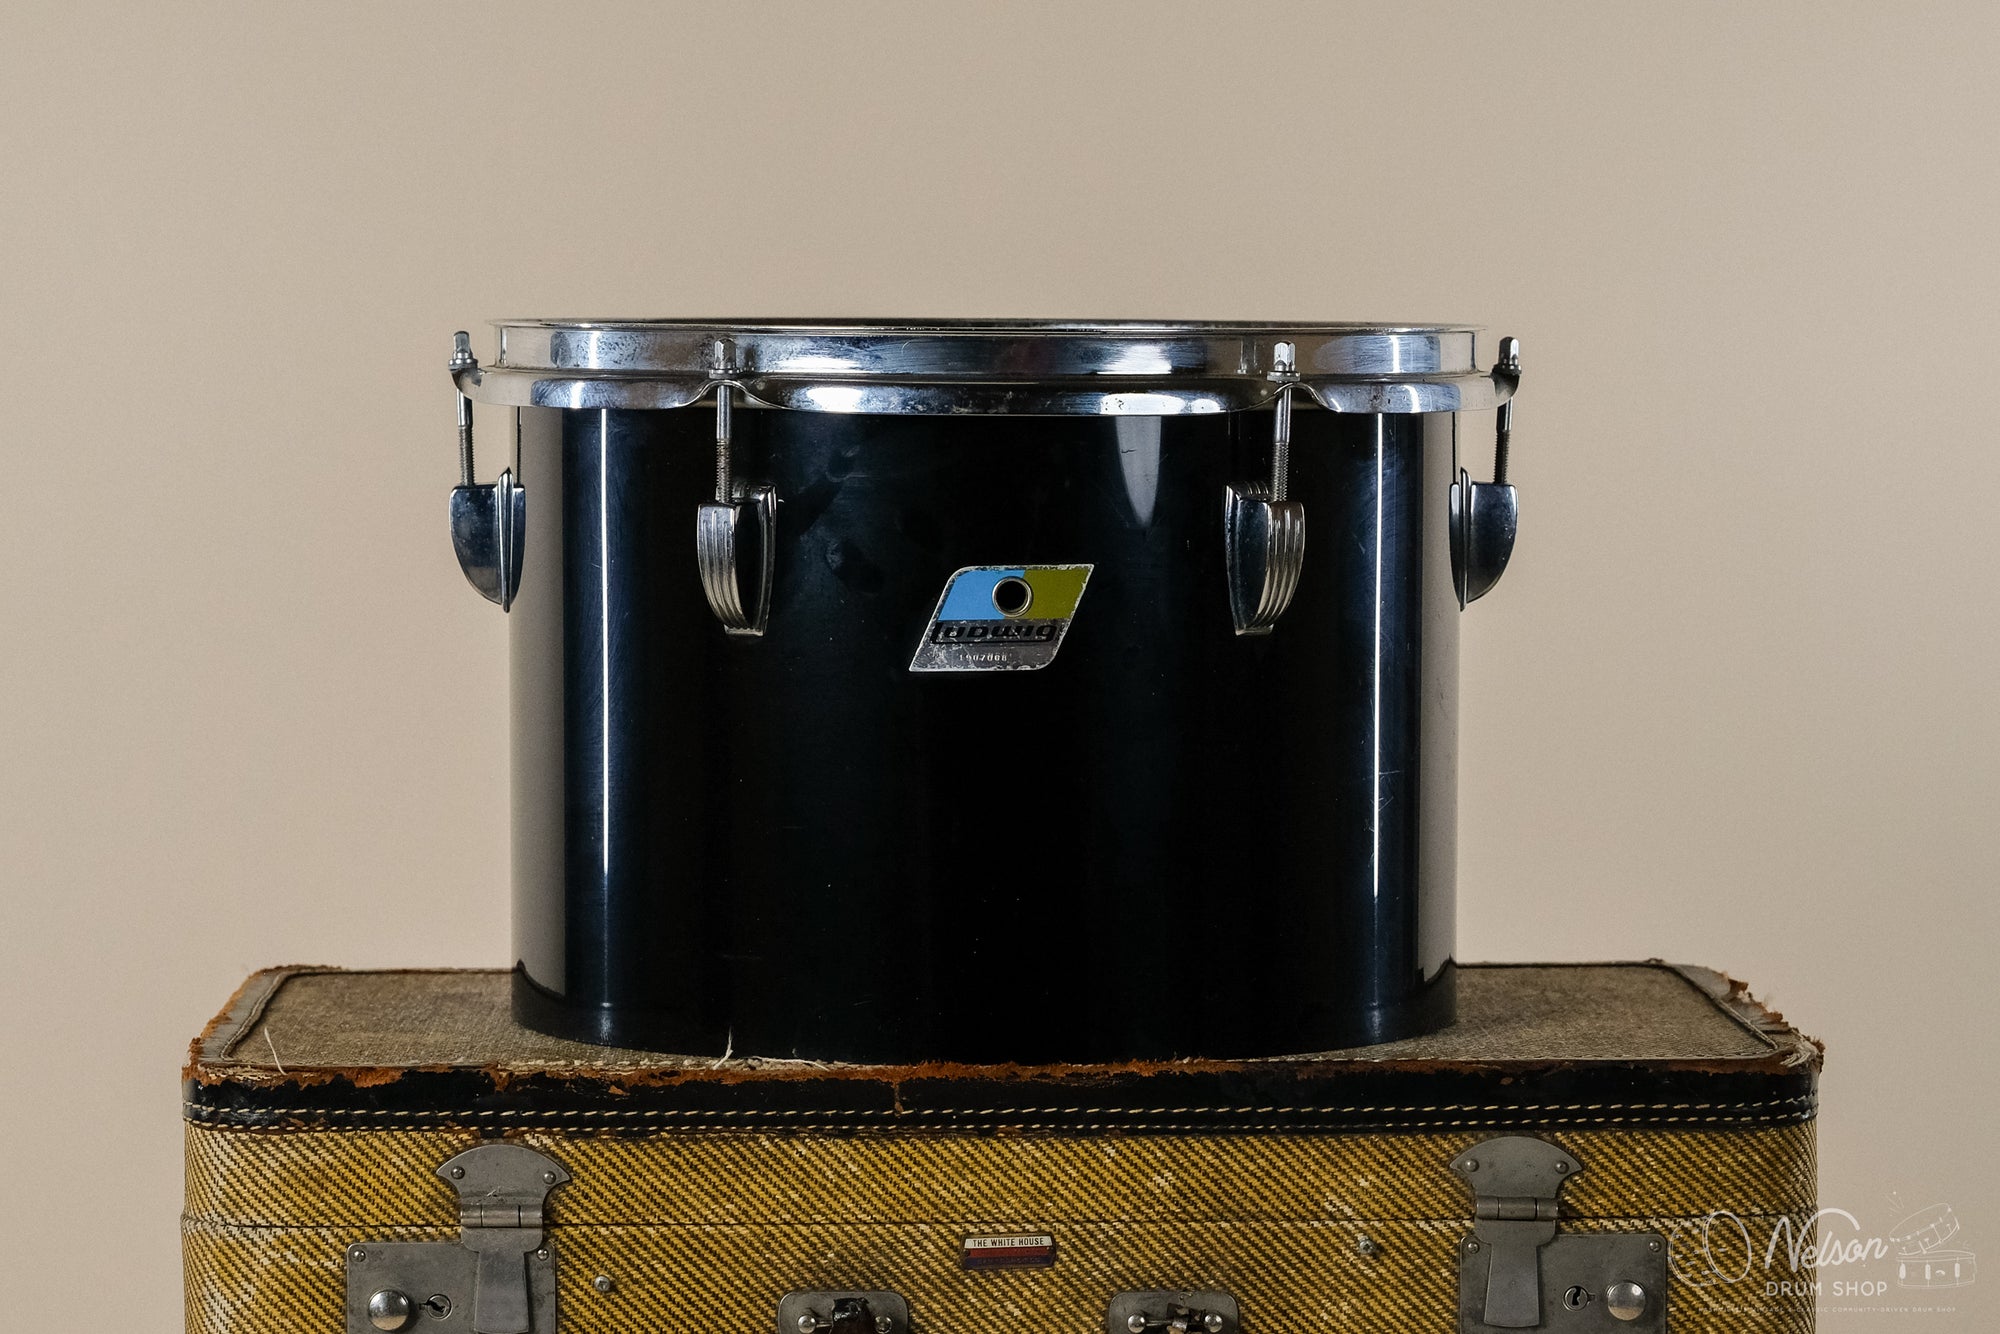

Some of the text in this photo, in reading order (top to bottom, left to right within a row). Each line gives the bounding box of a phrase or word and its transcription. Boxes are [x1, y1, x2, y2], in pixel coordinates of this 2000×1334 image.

[972, 1237, 1044, 1247] THE WHITE HOUSE
